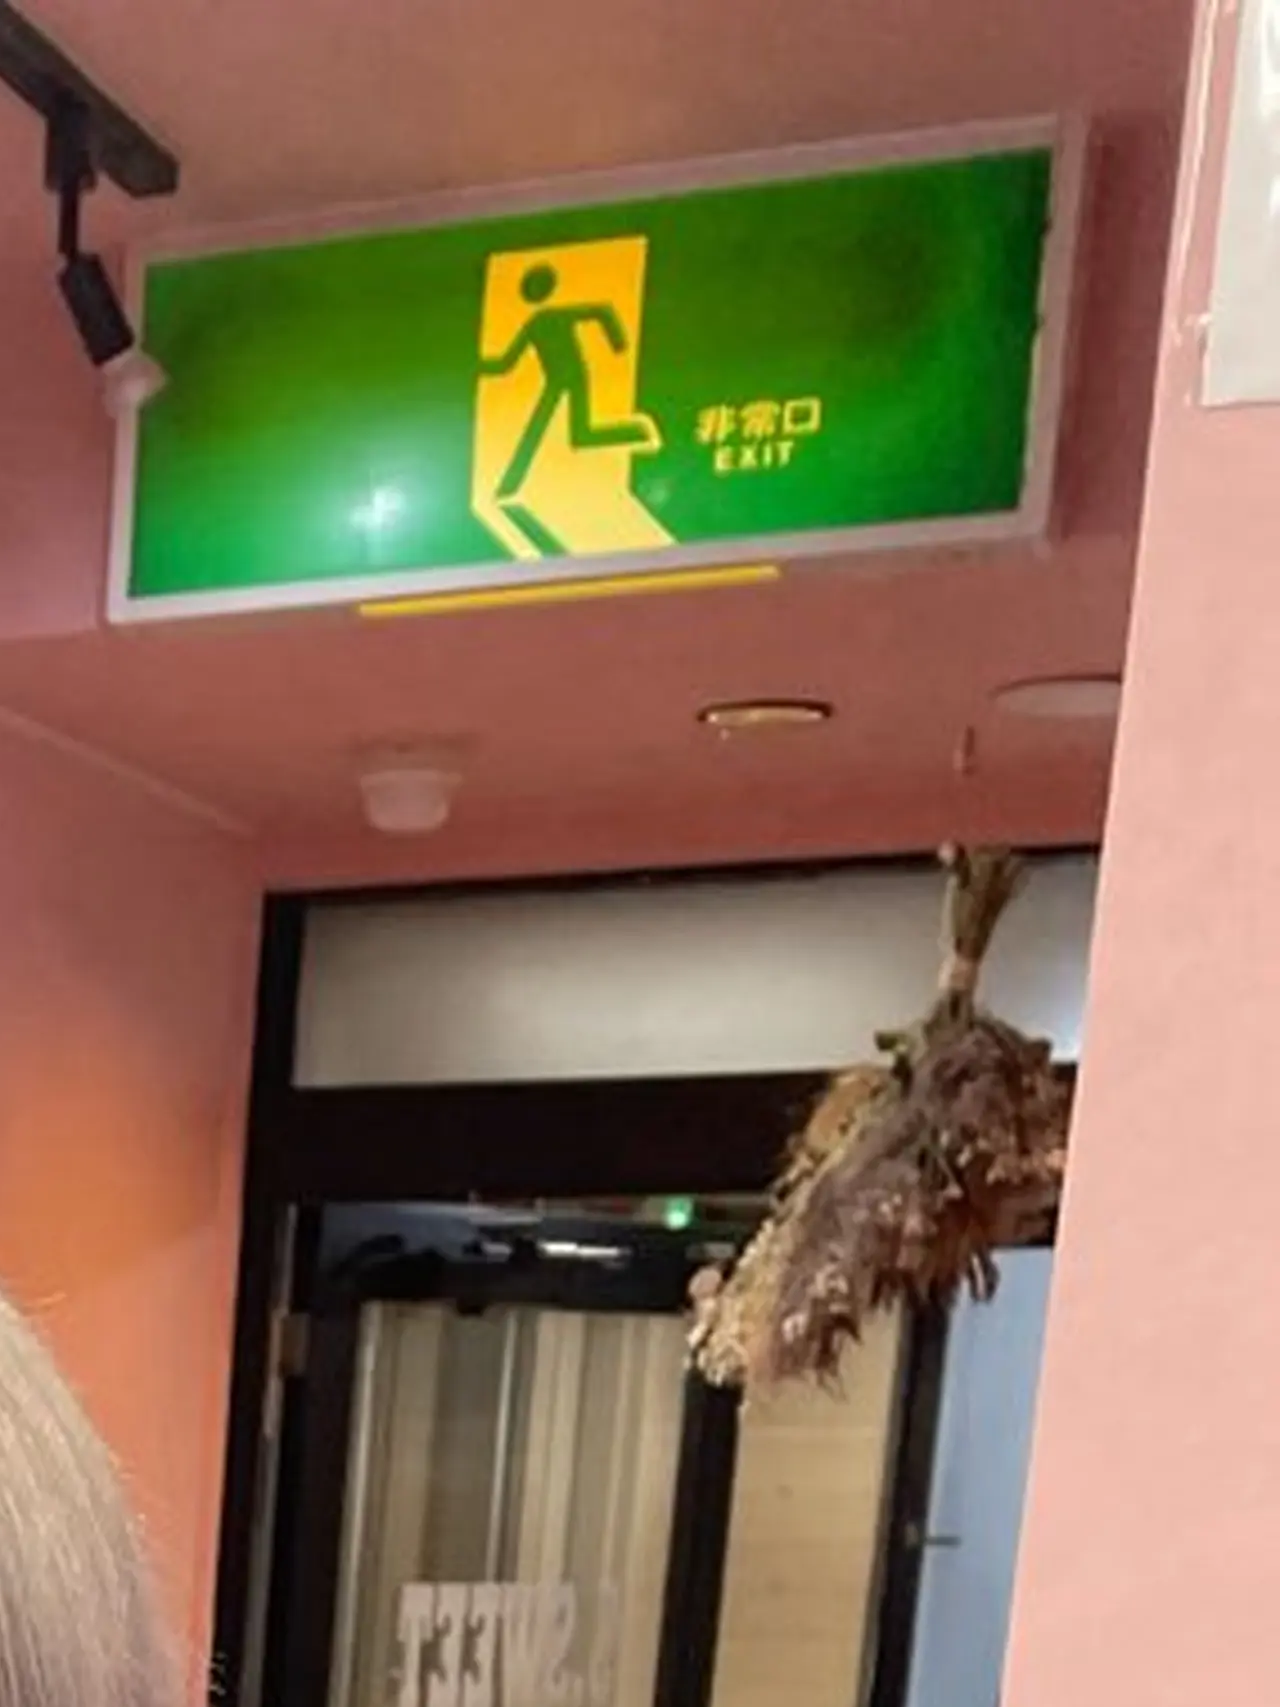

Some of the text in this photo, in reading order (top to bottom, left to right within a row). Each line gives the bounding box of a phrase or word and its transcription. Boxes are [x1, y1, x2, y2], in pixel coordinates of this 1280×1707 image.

[696, 398, 822, 443] 非常口
[714, 440, 793, 473] EXIT
